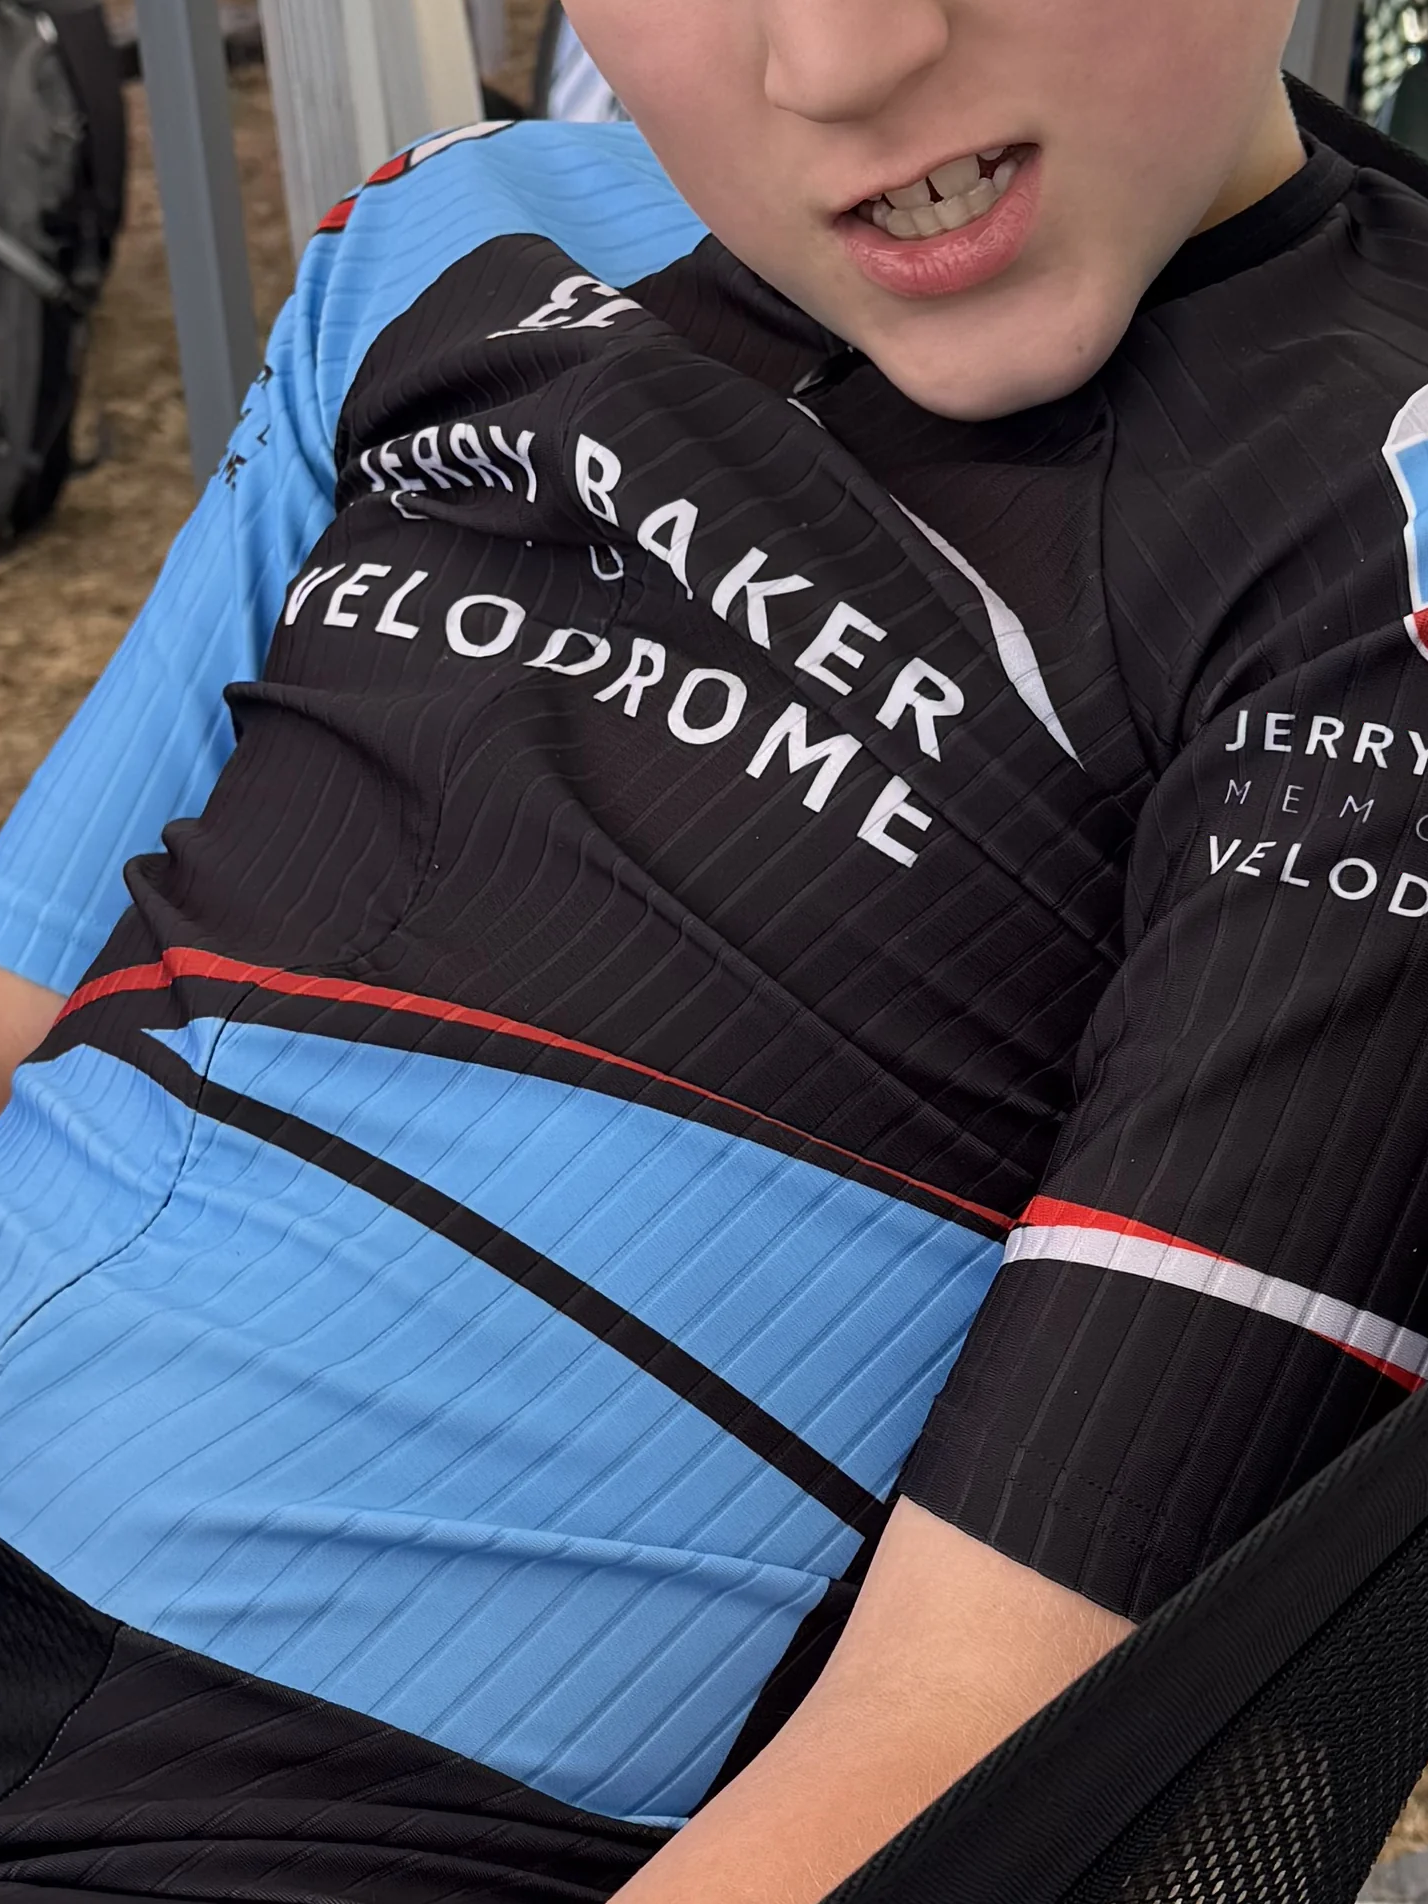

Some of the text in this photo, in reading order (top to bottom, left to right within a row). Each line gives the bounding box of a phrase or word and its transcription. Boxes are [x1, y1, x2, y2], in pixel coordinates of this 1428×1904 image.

[284, 562, 934, 870] VELODROME
[359, 422, 538, 504] JERRY
[574, 433, 965, 763] BAKER
